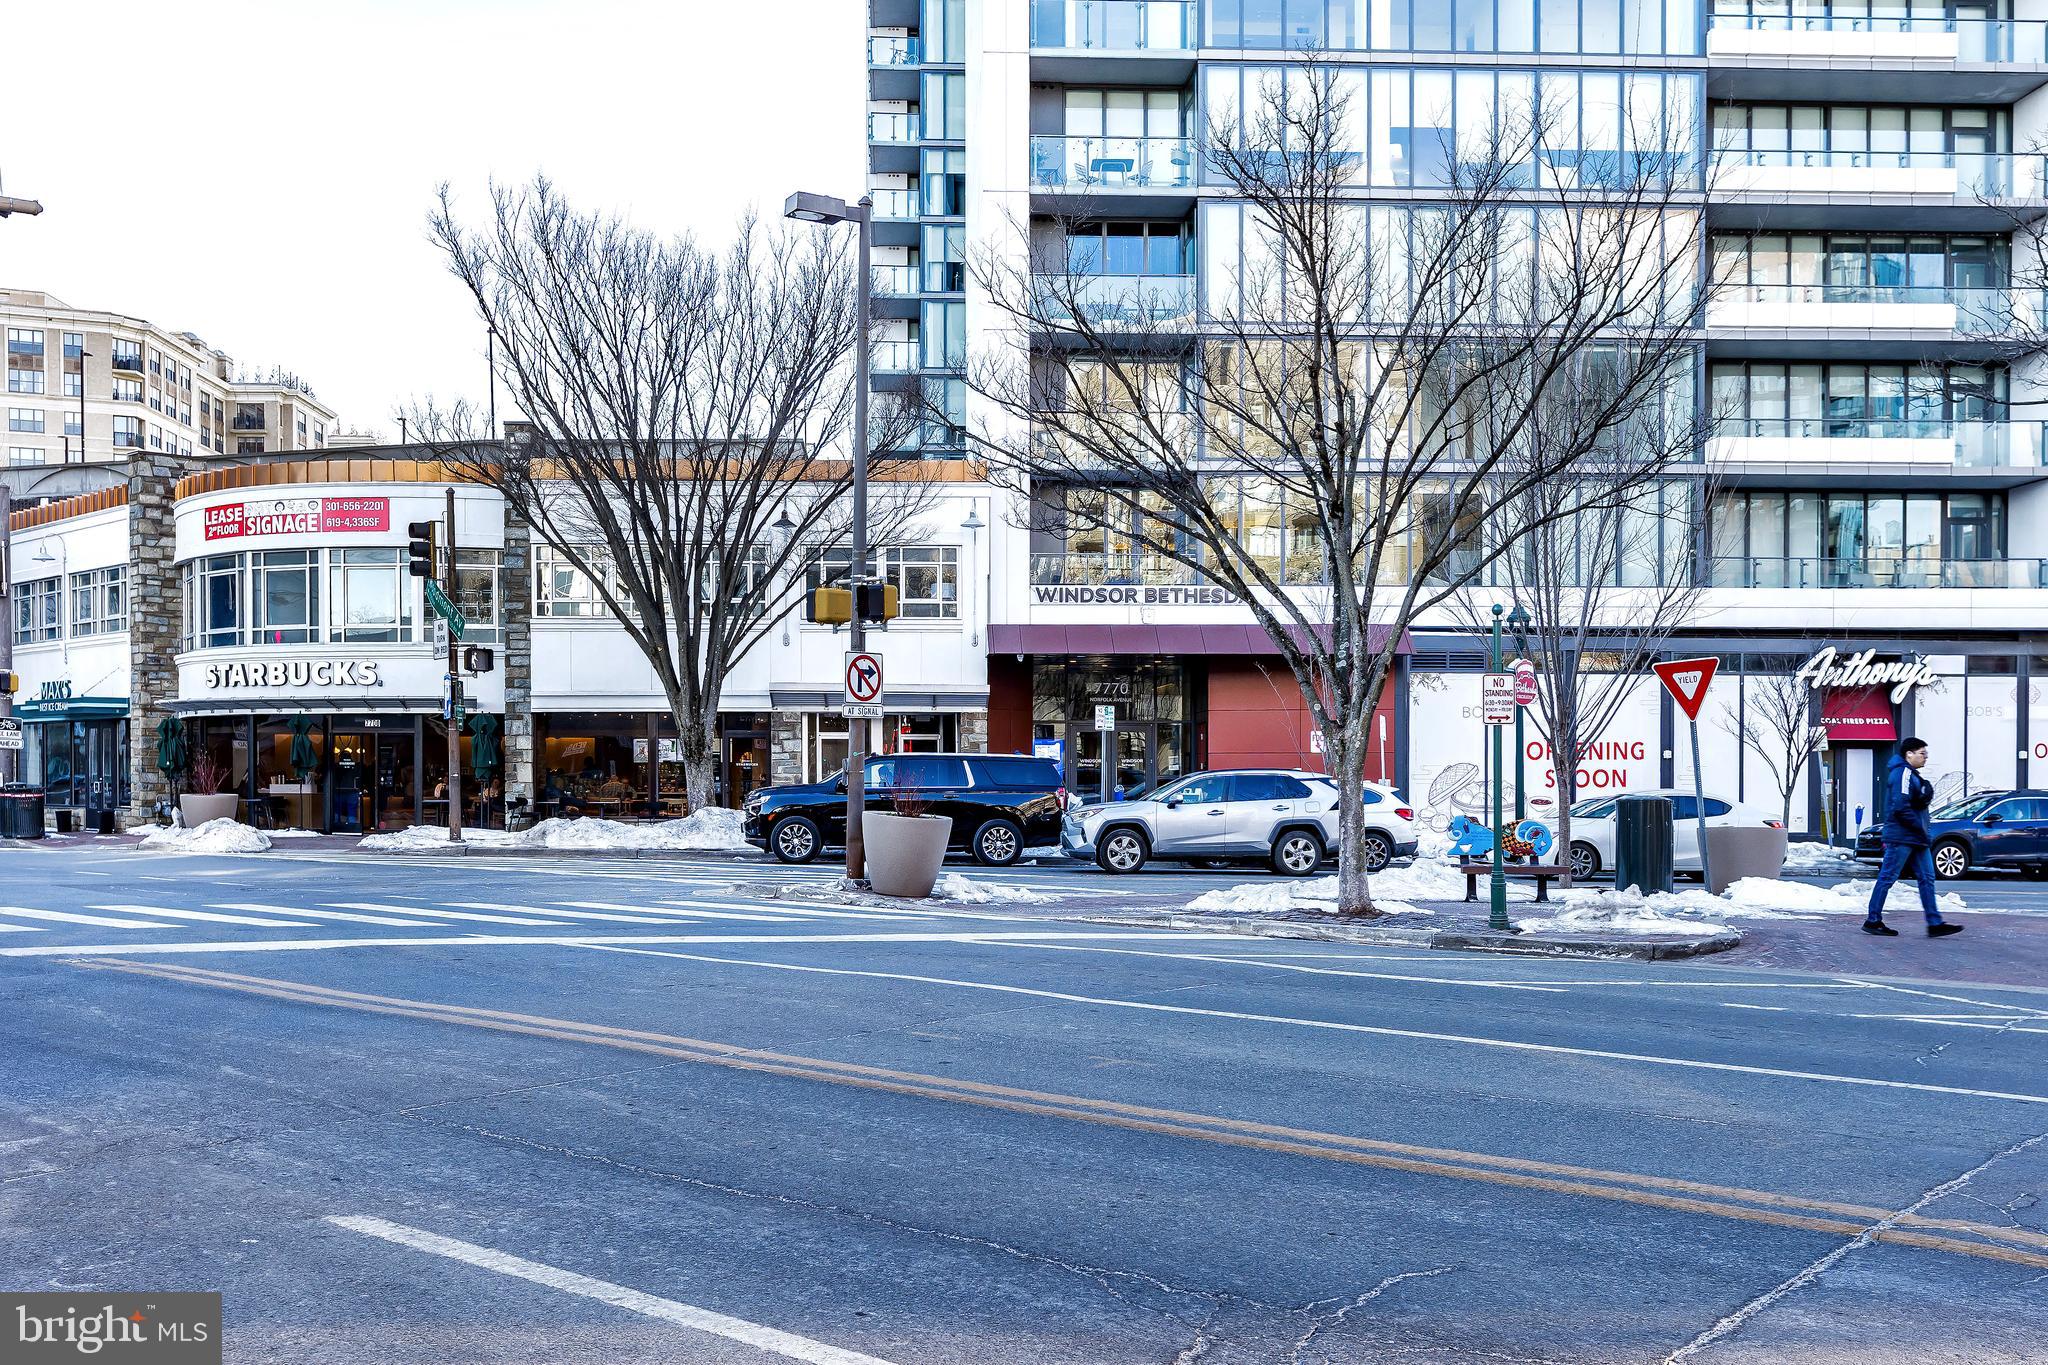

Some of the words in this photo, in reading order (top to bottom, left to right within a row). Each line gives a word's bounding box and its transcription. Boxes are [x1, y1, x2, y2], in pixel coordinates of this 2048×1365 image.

[325, 501, 384, 511] 301-656-2201
[205, 507, 242, 525] LEASE
[246, 513, 319, 535] SIGNAGE
[326, 517, 381, 528] 619-4,336SF
[217, 524, 240, 535] FLOOR
[1035, 587, 1138, 604] WINDSOR
[436, 635, 446, 643] TURN
[206, 660, 379, 689] STARBUCKS
[1678, 675, 1698, 684] YIELD
[1795, 646, 1938, 704] Anthony's
[1094, 682, 1129, 694] 7770
[1493, 678, 1505, 688] NO
[41, 680, 72, 700] MAX'S
[1484, 690, 1514, 698] STANDING
[848, 707, 855, 715] AT
[858, 707, 879, 715] SIGNAL
[1842, 717, 1865, 725] FIRED
[1865, 717, 1890, 725] PIZZA
